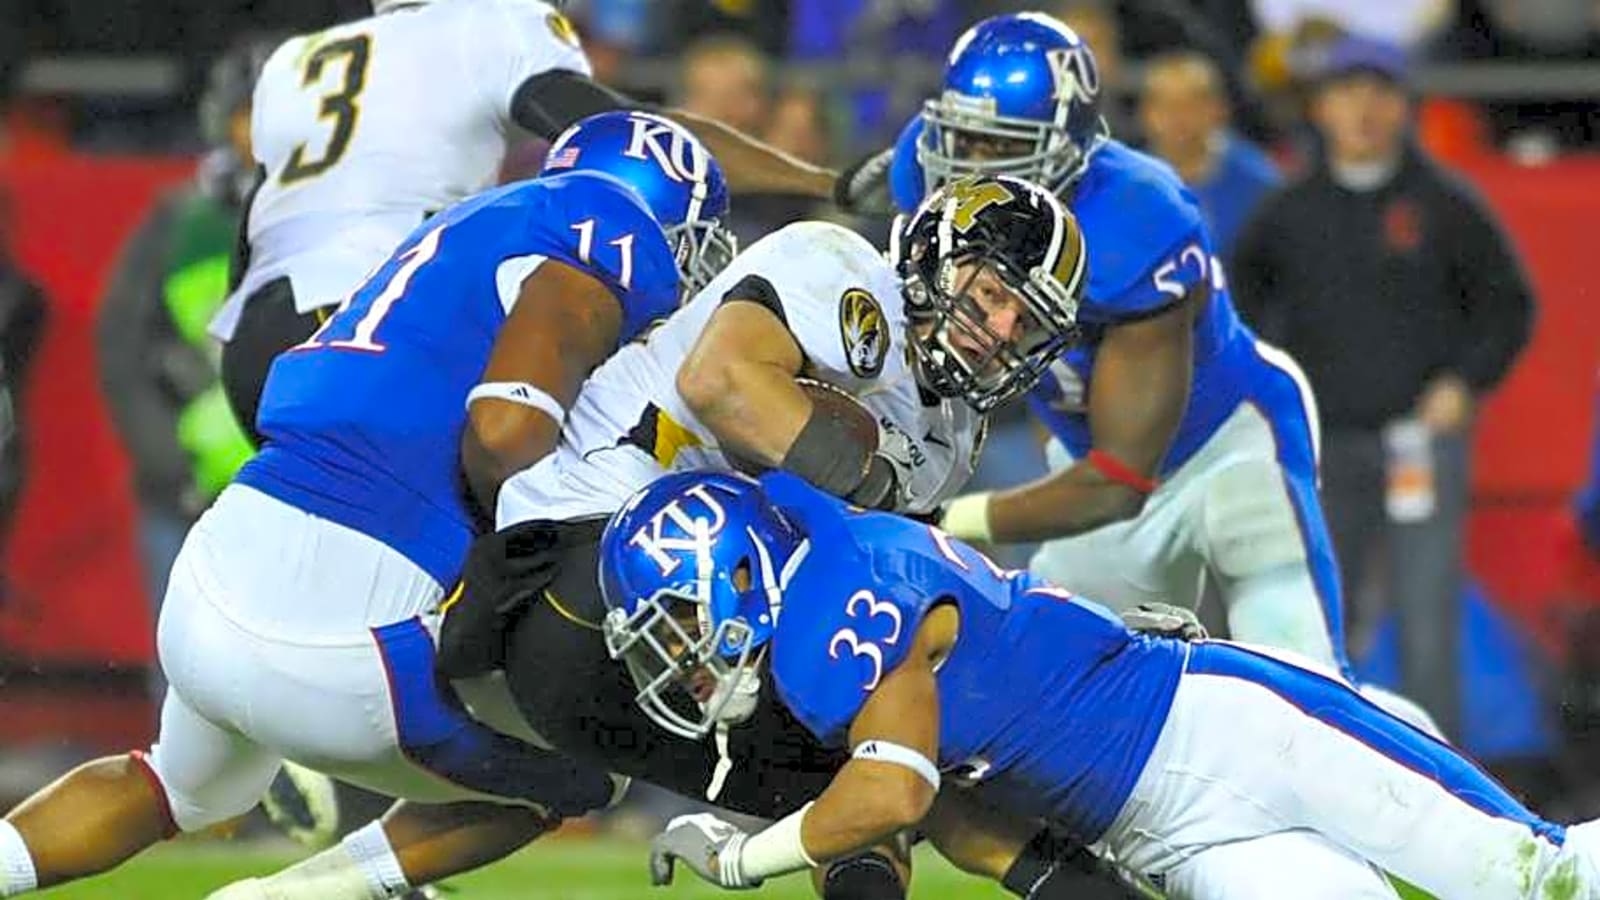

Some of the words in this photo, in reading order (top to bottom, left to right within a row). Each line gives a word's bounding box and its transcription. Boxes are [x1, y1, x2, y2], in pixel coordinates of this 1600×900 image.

[280, 34, 370, 186] 3
[1045, 46, 1100, 104] KU
[623, 116, 708, 182] KU
[569, 218, 634, 291] 11
[629, 484, 727, 578] KU
[827, 589, 904, 692] 33
